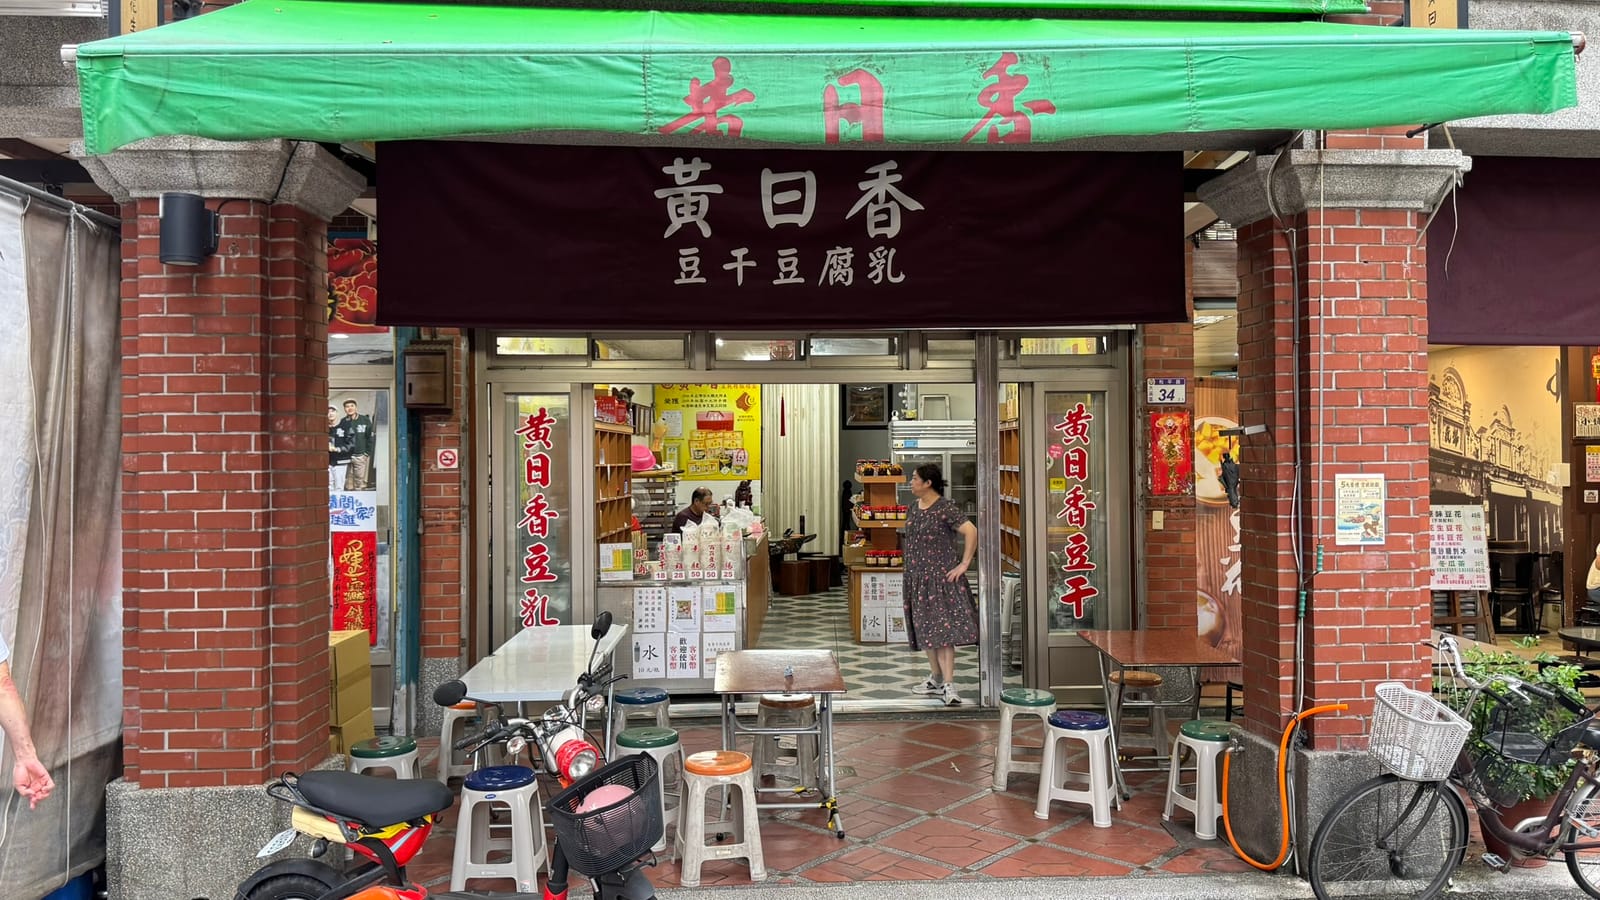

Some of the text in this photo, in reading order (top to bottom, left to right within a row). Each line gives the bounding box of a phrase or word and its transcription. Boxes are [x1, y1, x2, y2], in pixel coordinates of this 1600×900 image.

[654, 157, 925, 239] 黃日香
[674, 246, 906, 287] 豆干豆腐乳
[1158, 388, 1175, 401] 34
[515, 407, 560, 629] 黃日香豆乳
[1054, 402, 1099, 620] 黃日香豆干
[868, 615, 881, 628] 水
[642, 644, 659, 661] 水
[679, 637, 687, 670] 歡迎使用
